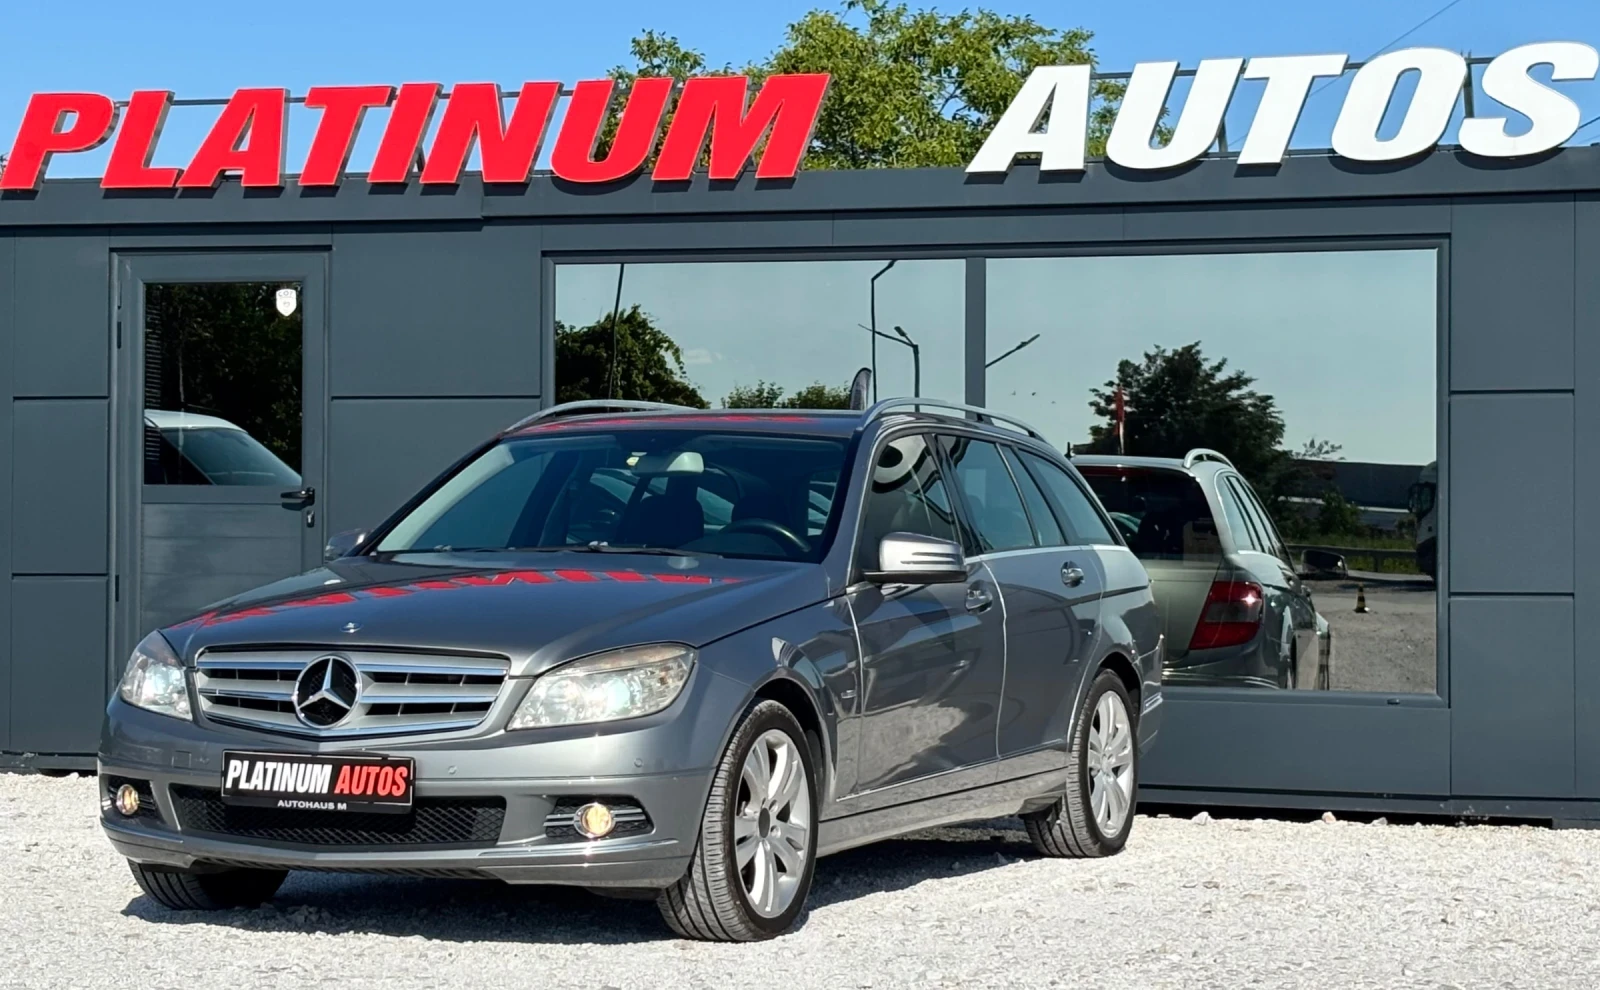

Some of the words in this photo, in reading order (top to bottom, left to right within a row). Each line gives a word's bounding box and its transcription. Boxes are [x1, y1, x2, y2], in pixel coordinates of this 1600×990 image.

[0, 73, 831, 192] PLATINUM
[965, 41, 1599, 173] AUTOS
[225, 759, 333, 794] PLATINUM
[334, 764, 408, 797] AUTOS
[277, 800, 335, 810] AUTOHAUS
